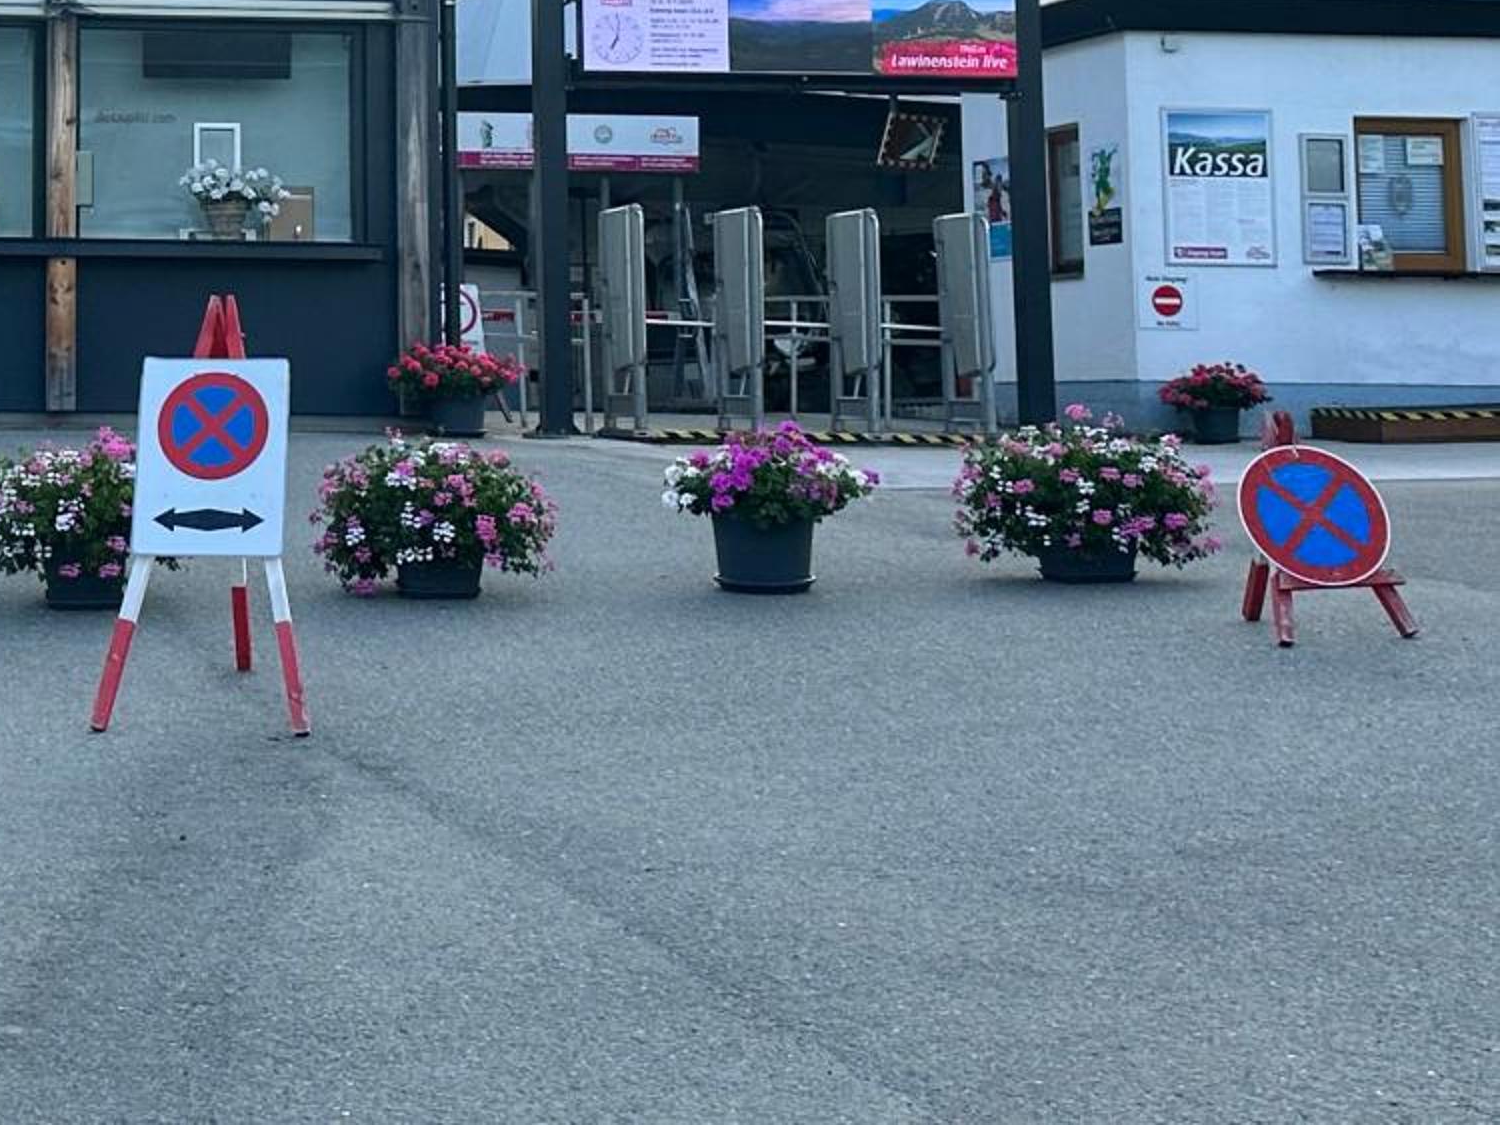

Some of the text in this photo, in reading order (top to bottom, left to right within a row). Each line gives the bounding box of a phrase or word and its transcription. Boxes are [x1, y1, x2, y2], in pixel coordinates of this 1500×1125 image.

[891, 53, 1008, 70] Lawinenstein live
[1173, 146, 1265, 177] Kassa
